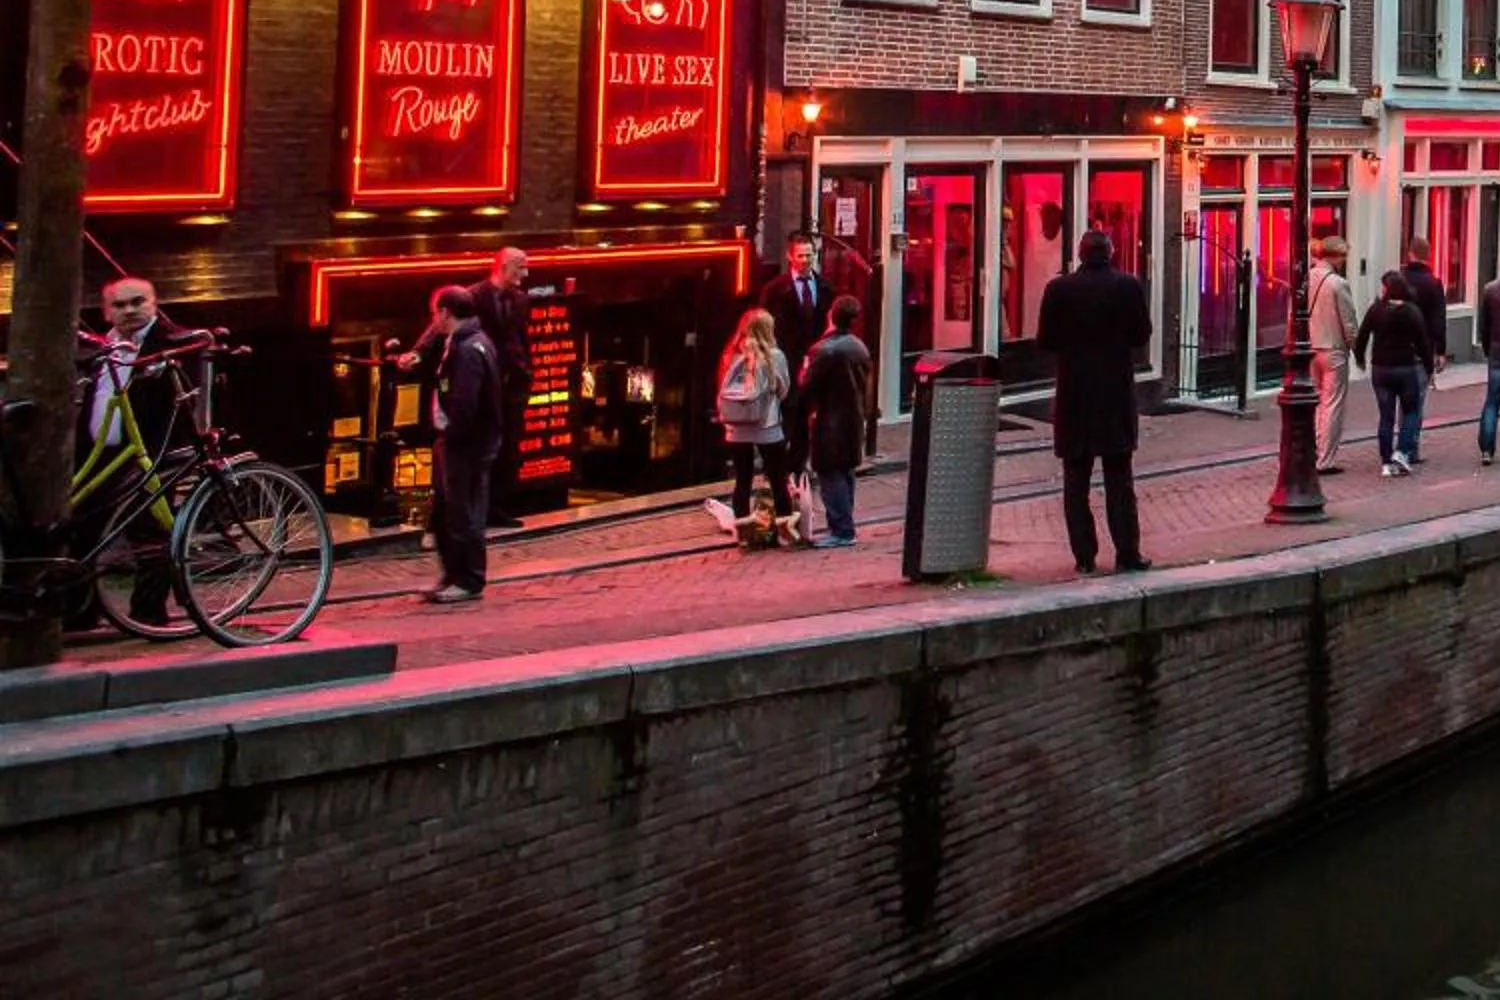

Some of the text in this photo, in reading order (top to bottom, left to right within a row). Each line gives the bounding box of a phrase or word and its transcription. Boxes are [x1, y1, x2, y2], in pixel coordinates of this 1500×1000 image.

[91, 32, 204, 75] ROTIC
[377, 39, 495, 78] MOULIN
[608, 52, 715, 87] LIVE SEX
[85, 89, 213, 154] ghtclub
[391, 85, 480, 140] Rouge
[616, 105, 704, 145] theater
